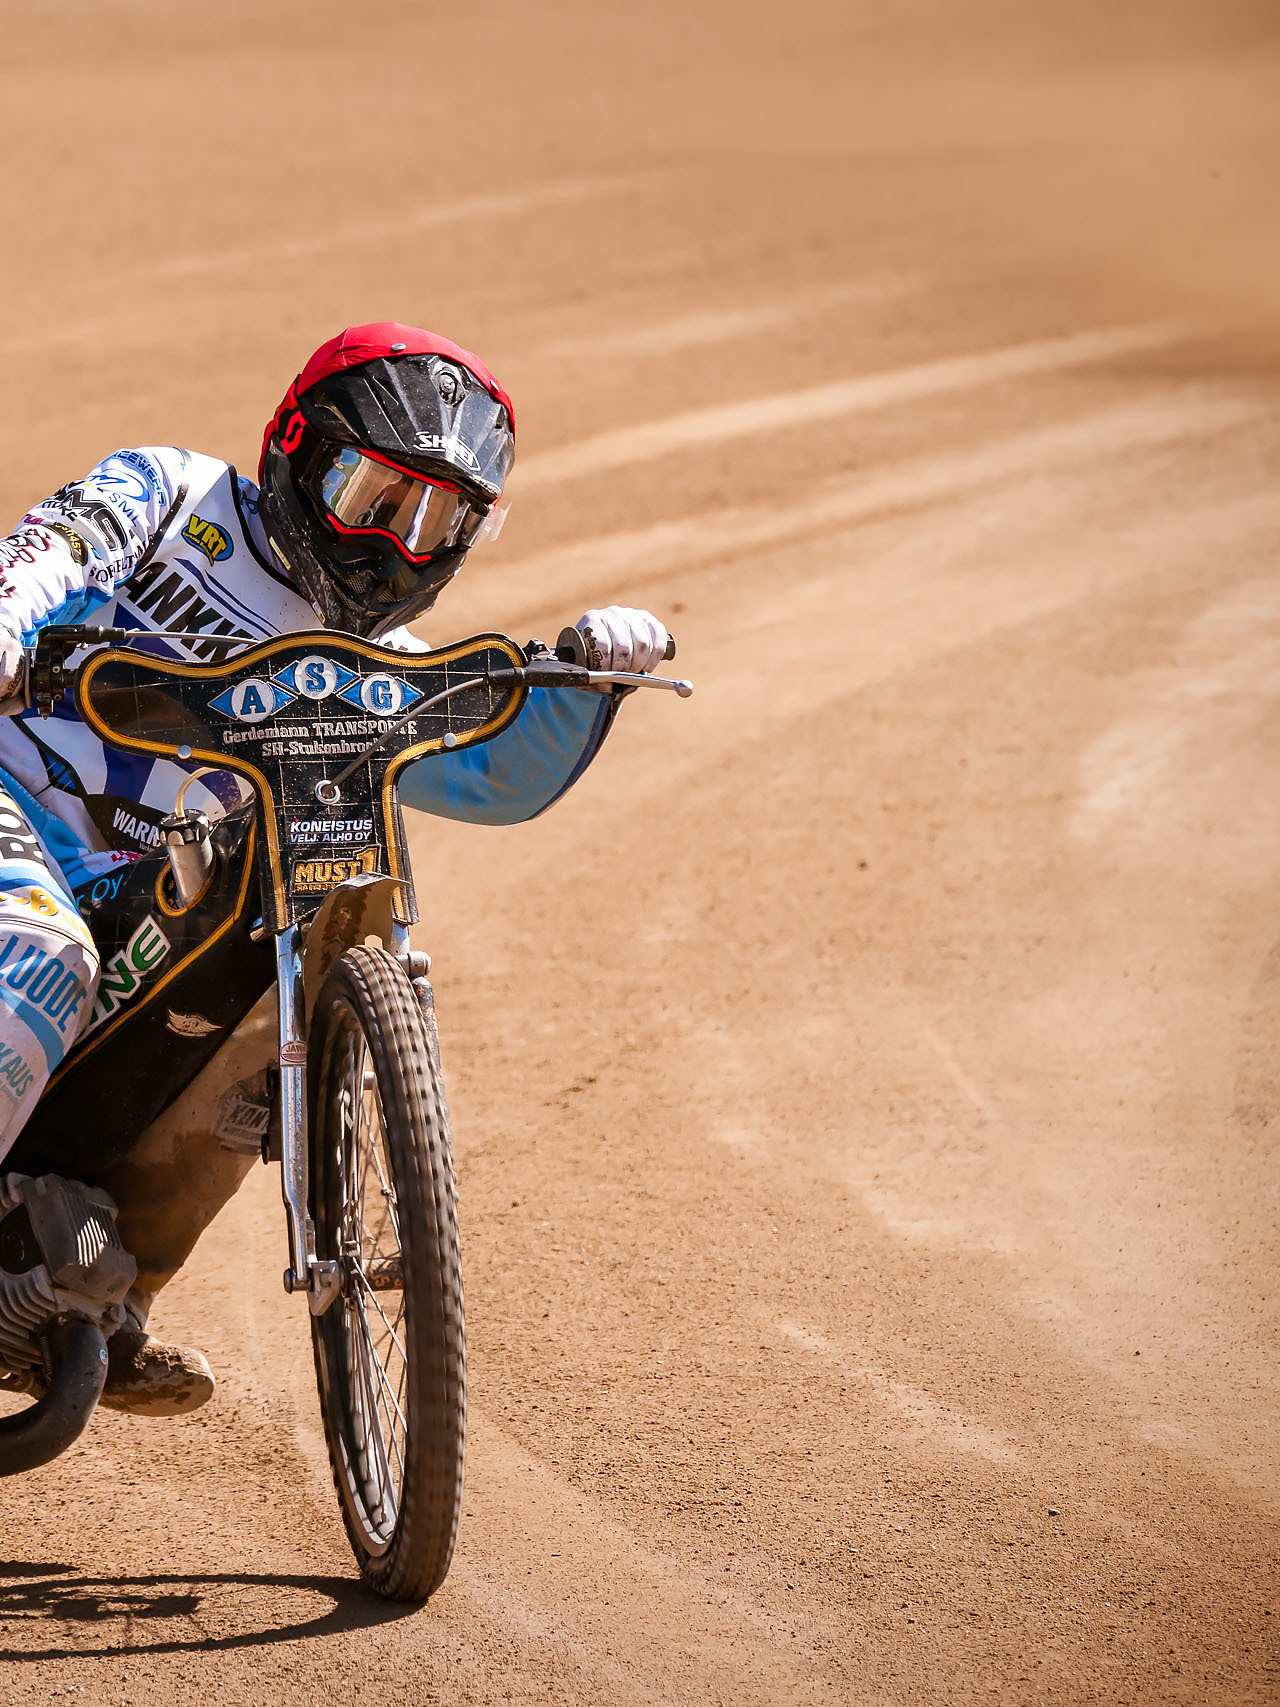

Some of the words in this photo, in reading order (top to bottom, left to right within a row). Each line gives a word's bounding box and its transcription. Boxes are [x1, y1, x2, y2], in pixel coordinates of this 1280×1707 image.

[108, 492, 139, 528] SML
[188, 514, 227, 559] VRT
[223, 725, 310, 744] Gerdemann
[290, 819, 373, 833] KONEISTUS
[322, 832, 352, 842] ALHO
[355, 831, 371, 841] OY
